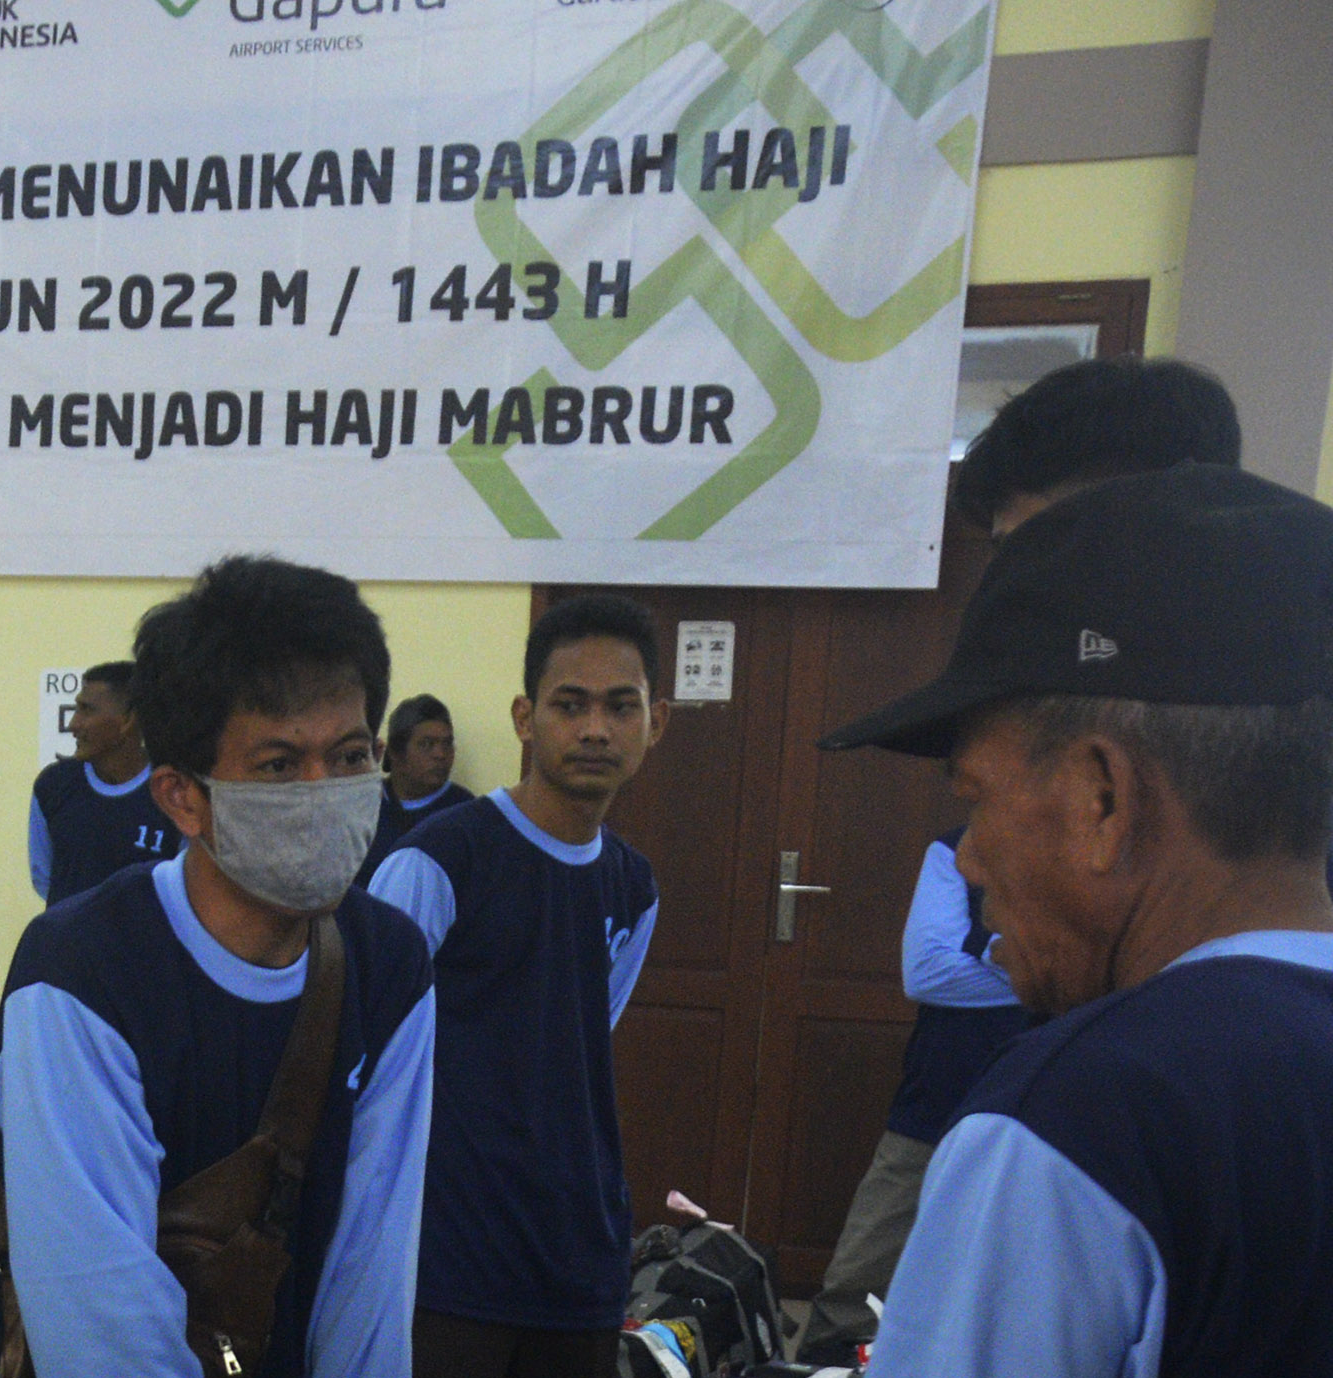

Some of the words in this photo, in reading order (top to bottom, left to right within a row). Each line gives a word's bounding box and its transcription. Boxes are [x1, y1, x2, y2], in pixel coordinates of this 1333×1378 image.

[229, 38, 291, 58] AIRPORT
[295, 34, 364, 54] SERVICES
[415, 132, 679, 203] IBADAH
[699, 124, 852, 202] HAJI
[77, 271, 239, 331] 2022
[259, 268, 309, 326] M
[328, 265, 361, 337] /
[391, 260, 561, 323] 1443
[583, 258, 632, 320] H
[8, 389, 265, 460] MENJADI
[284, 388, 419, 460] HAJI
[437, 383, 735, 446] MABRUR
[45, 672, 83, 694] RO
[133, 824, 165, 853] 11
